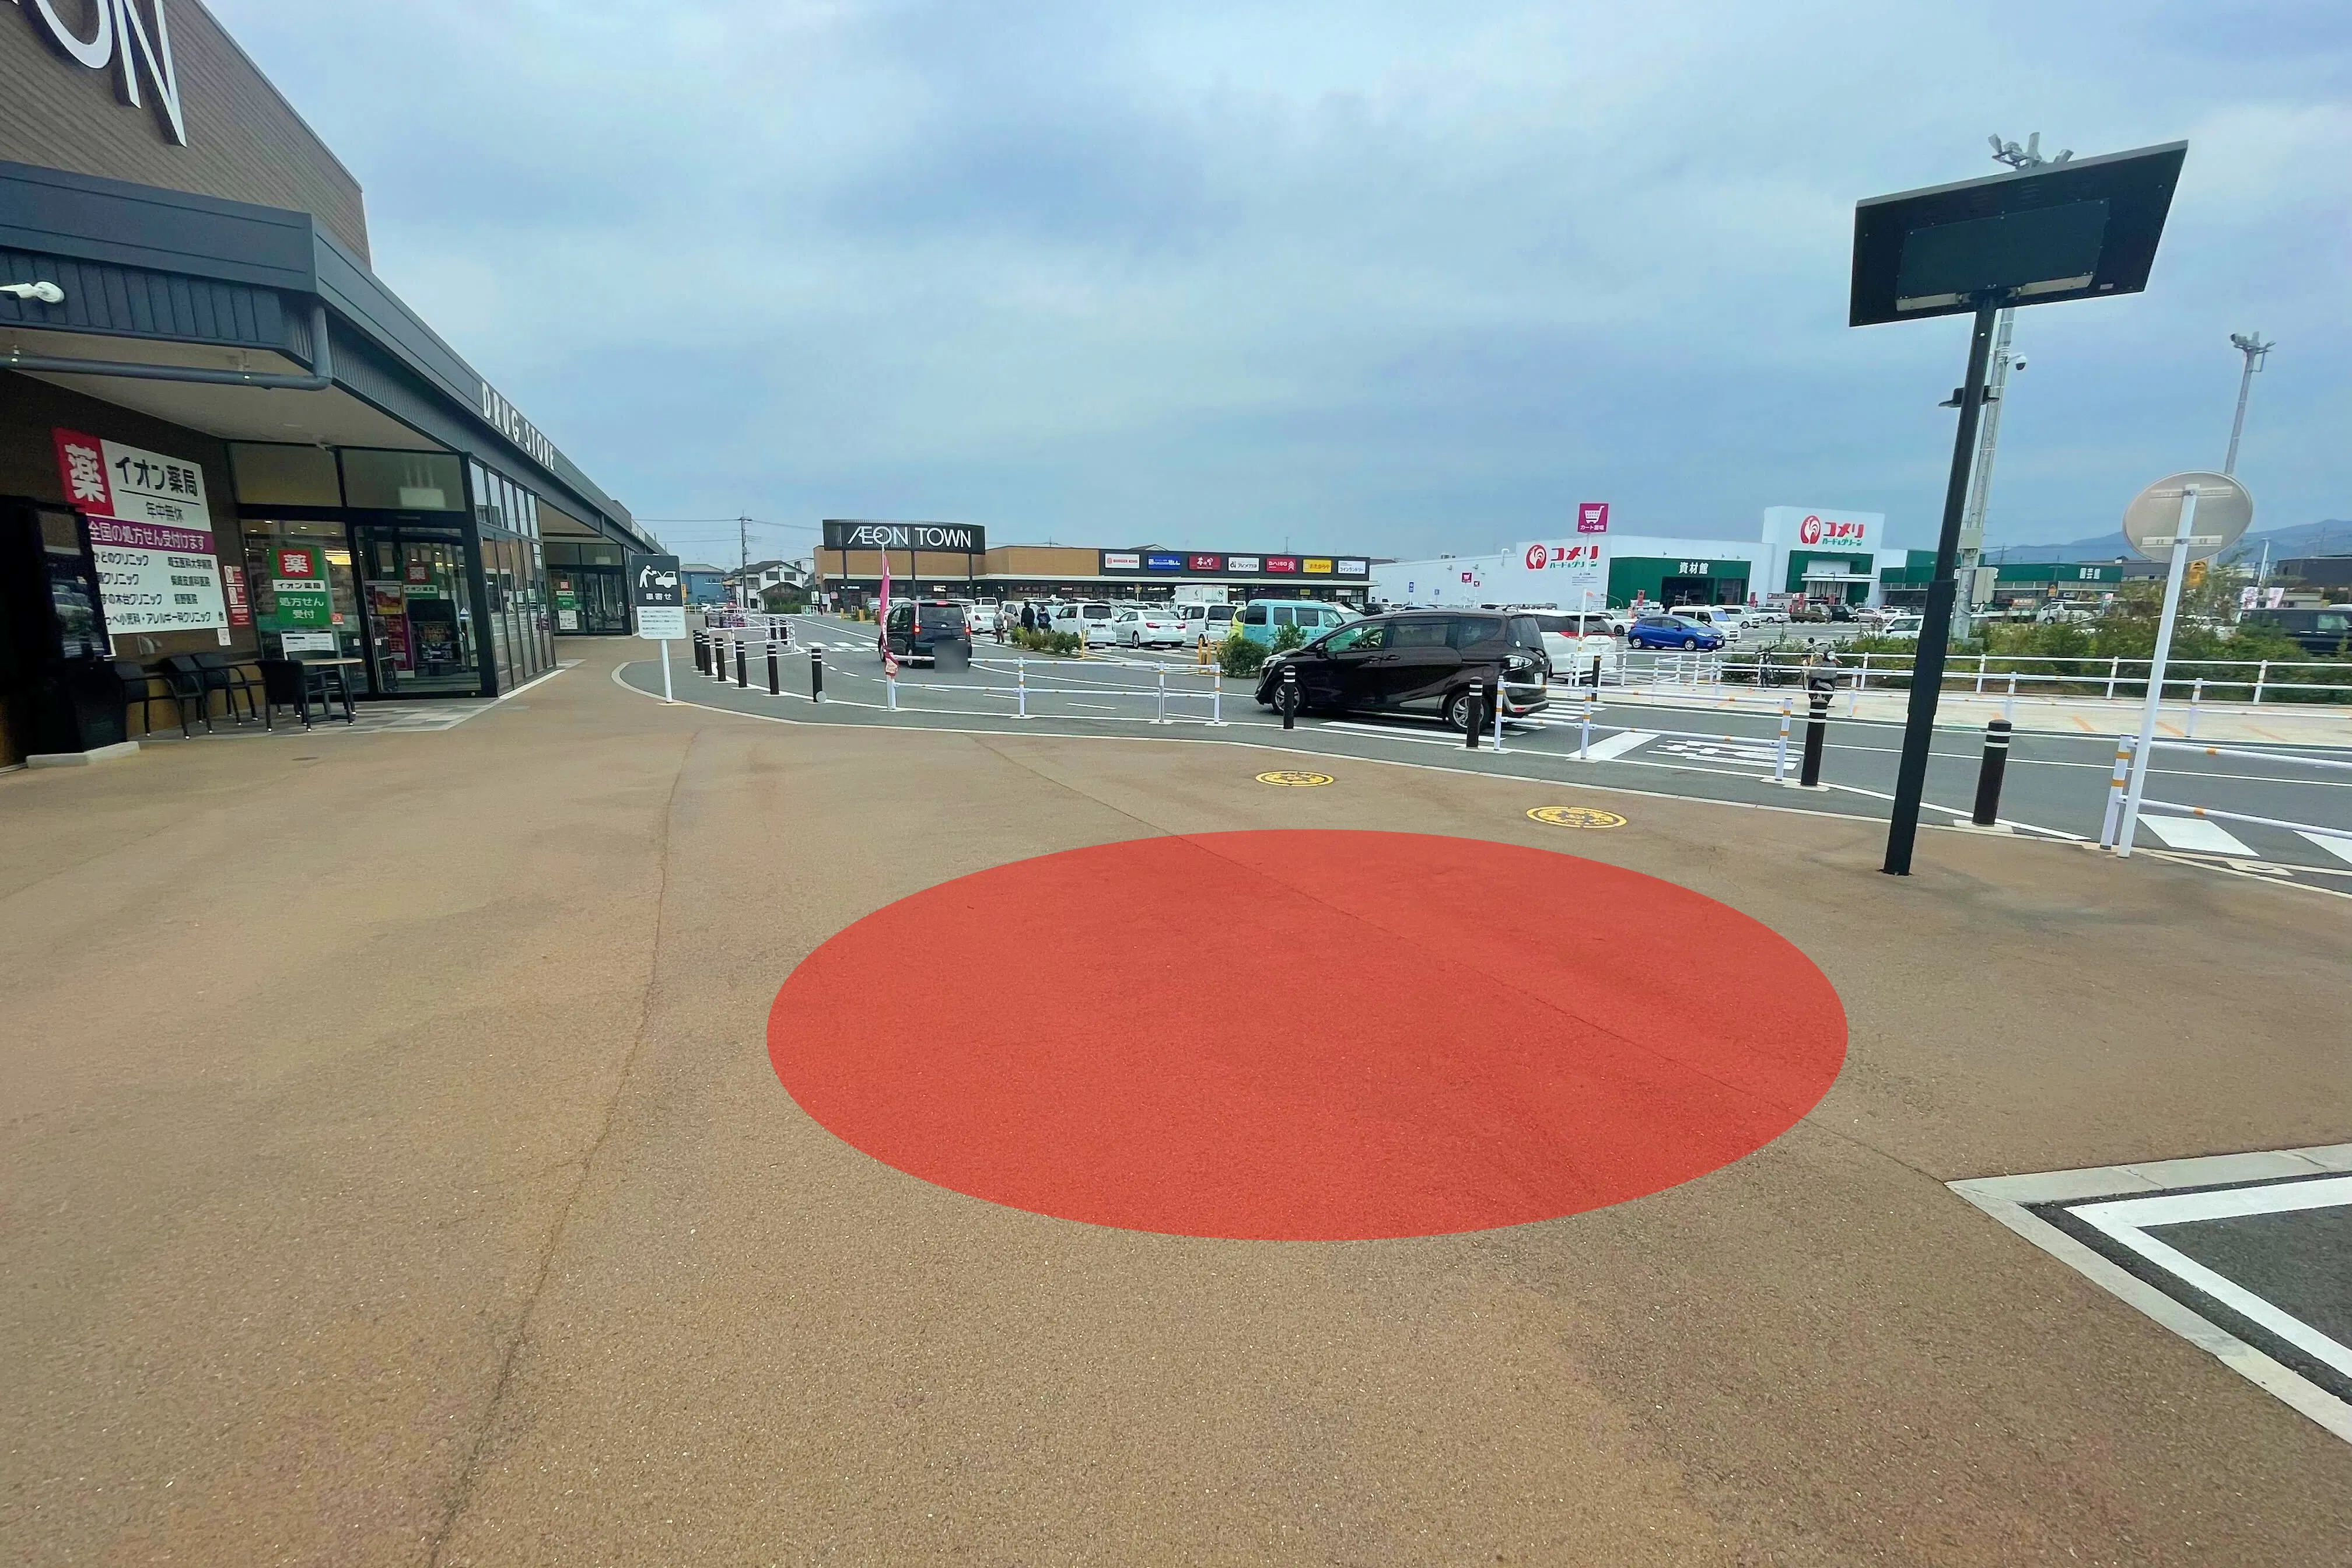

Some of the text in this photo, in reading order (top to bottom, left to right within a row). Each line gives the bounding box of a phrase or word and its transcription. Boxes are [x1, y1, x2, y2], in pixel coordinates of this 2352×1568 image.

[482, 382, 554, 471] DRUG STORE
[65, 443, 106, 503] 薬
[115, 456, 198, 497] イオン薬局
[146, 502, 184, 522] 年中無休
[89, 520, 205, 550] 全国の処方せん受付けます
[915, 527, 971, 548] TOWN
[1823, 522, 1864, 538] コメリ
[1550, 545, 1598, 561] コメリ
[284, 554, 309, 573] 薬
[1678, 562, 1709, 574] 資材館
[279, 597, 324, 607] 処方せん
[293, 610, 314, 619] 受付
